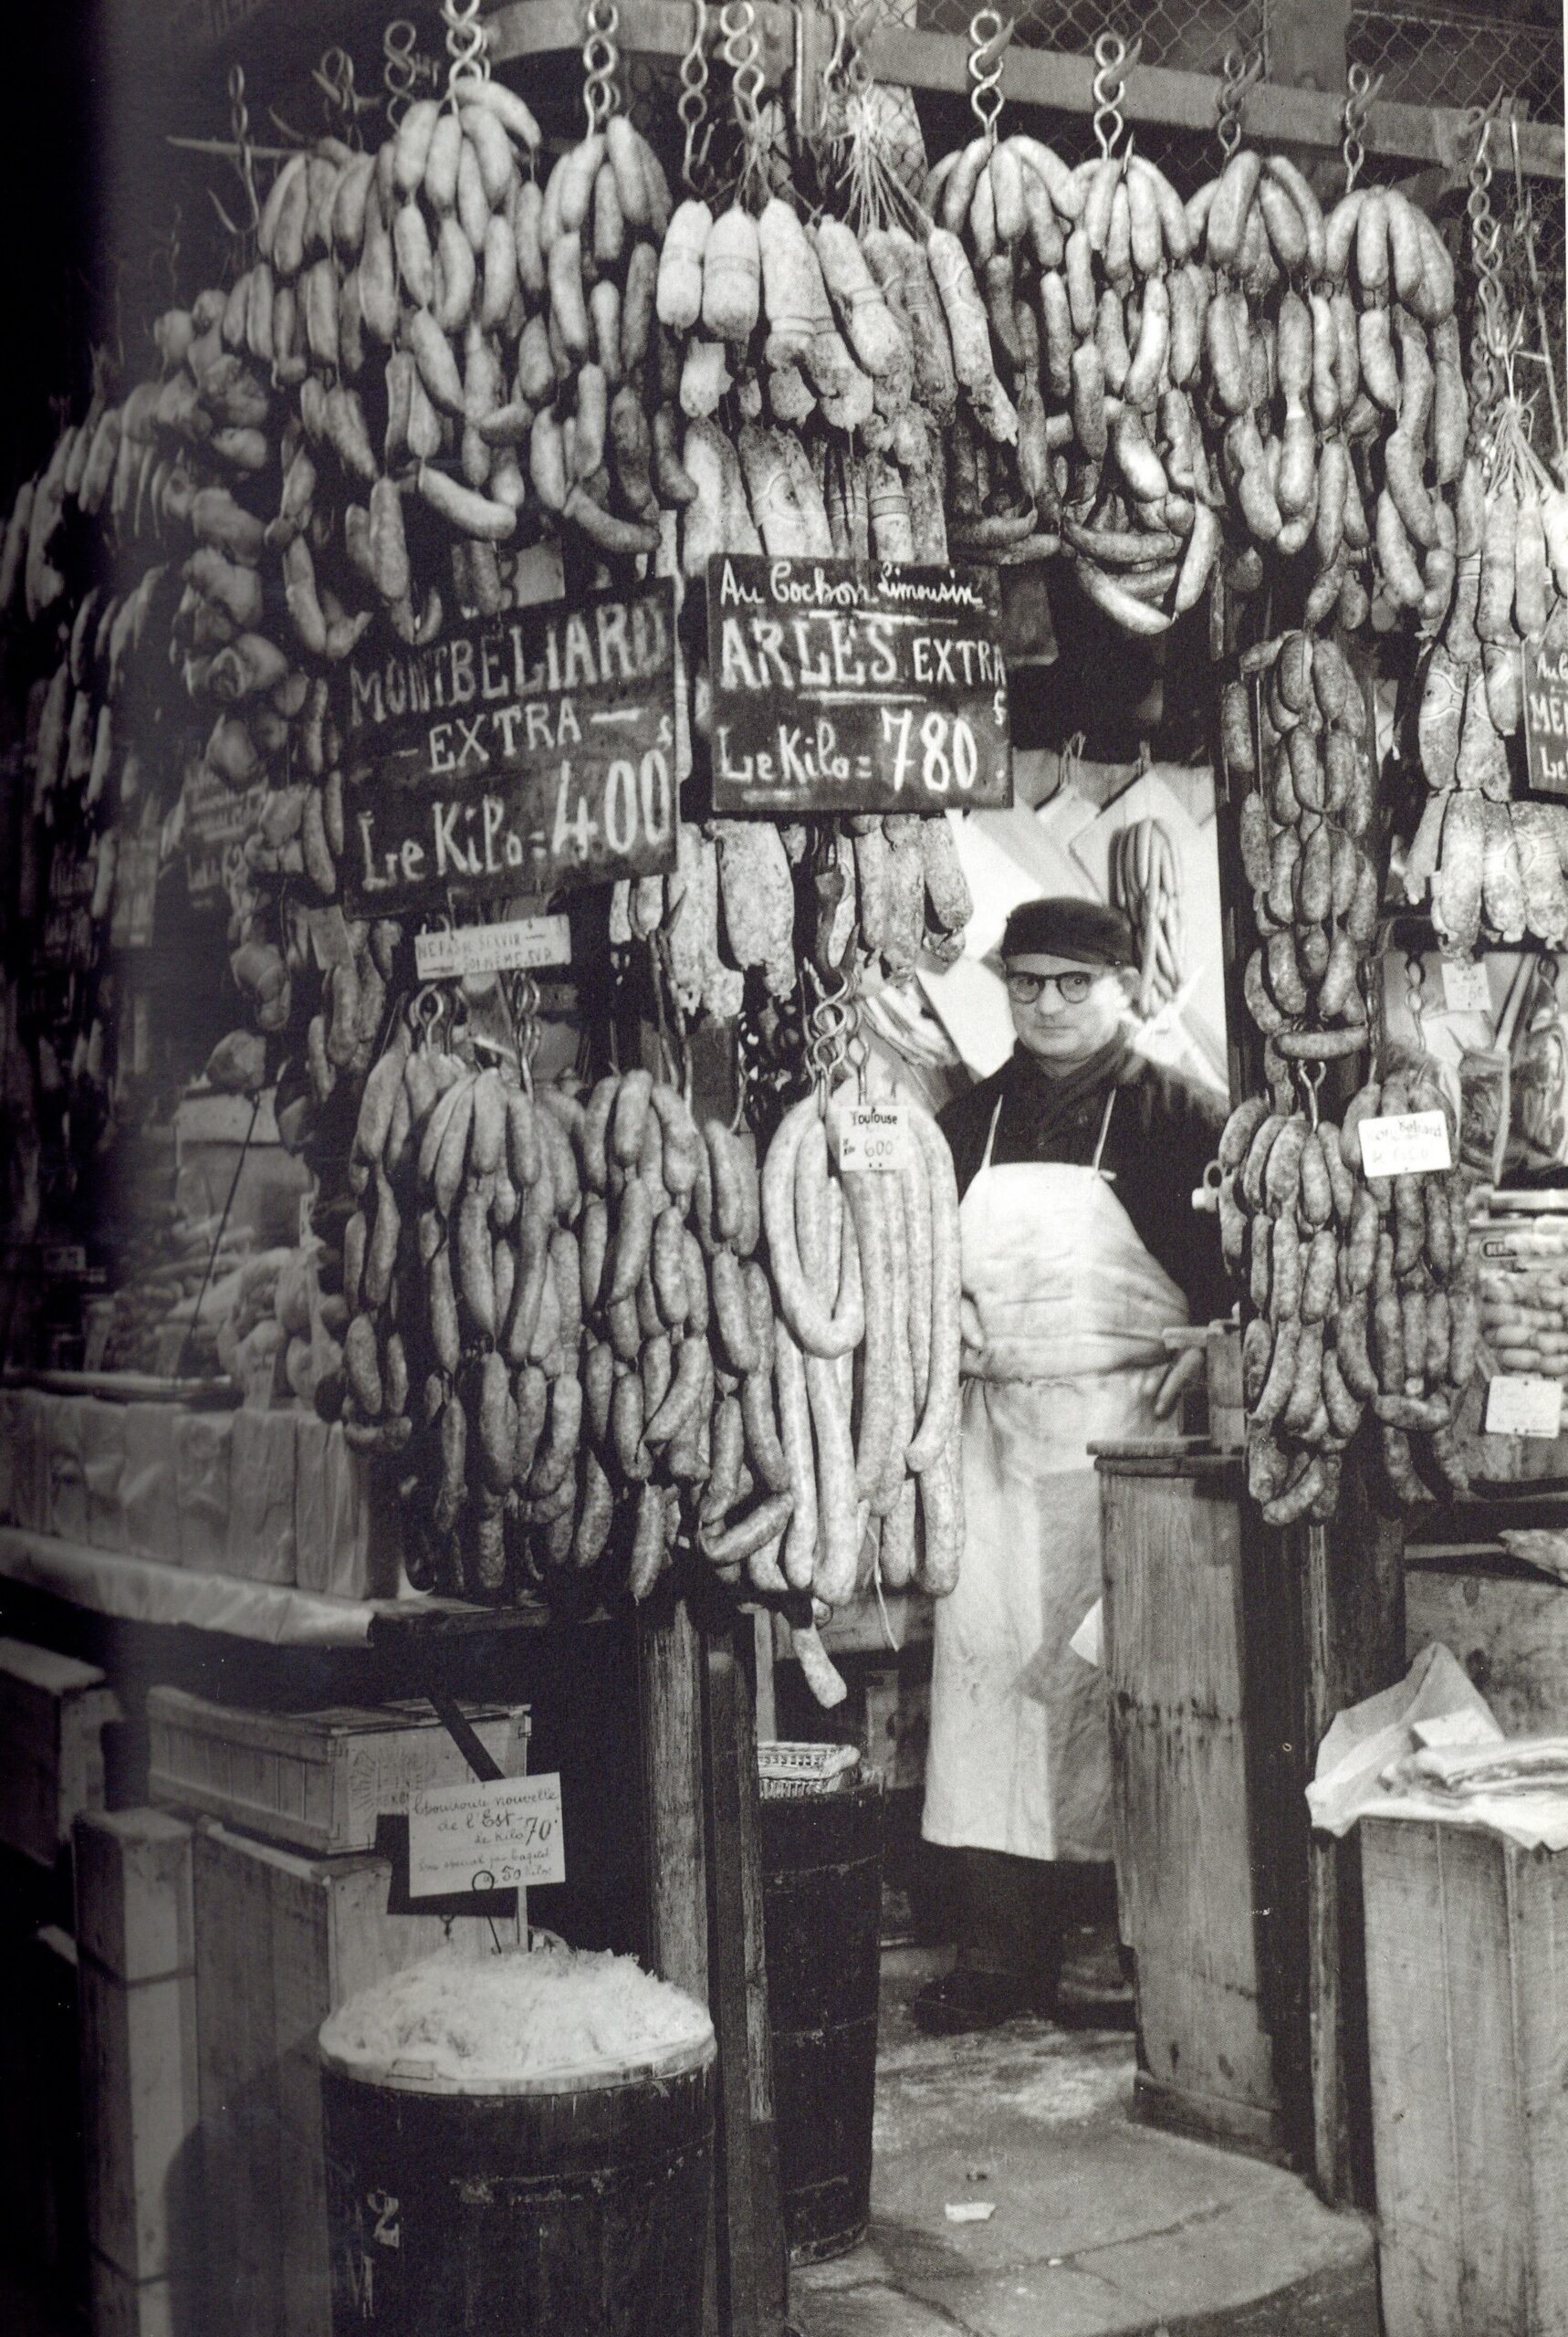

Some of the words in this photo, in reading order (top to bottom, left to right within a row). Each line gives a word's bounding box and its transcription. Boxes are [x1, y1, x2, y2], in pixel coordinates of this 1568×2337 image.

[720, 559, 764, 605] Au
[913, 636, 1007, 686] EXTRA
[429, 697, 582, 774] EXTRA
[717, 726, 773, 783] Le
[880, 707, 978, 793] 780
[358, 811, 425, 892] Le
[551, 749, 672, 860] 400
[850, 1106, 898, 1127] Toulouse
[863, 1138, 894, 1158] 600
[495, 1788, 559, 1807] nouvelle
[525, 1816, 552, 1847] 70
[501, 1864, 522, 1881] 50
